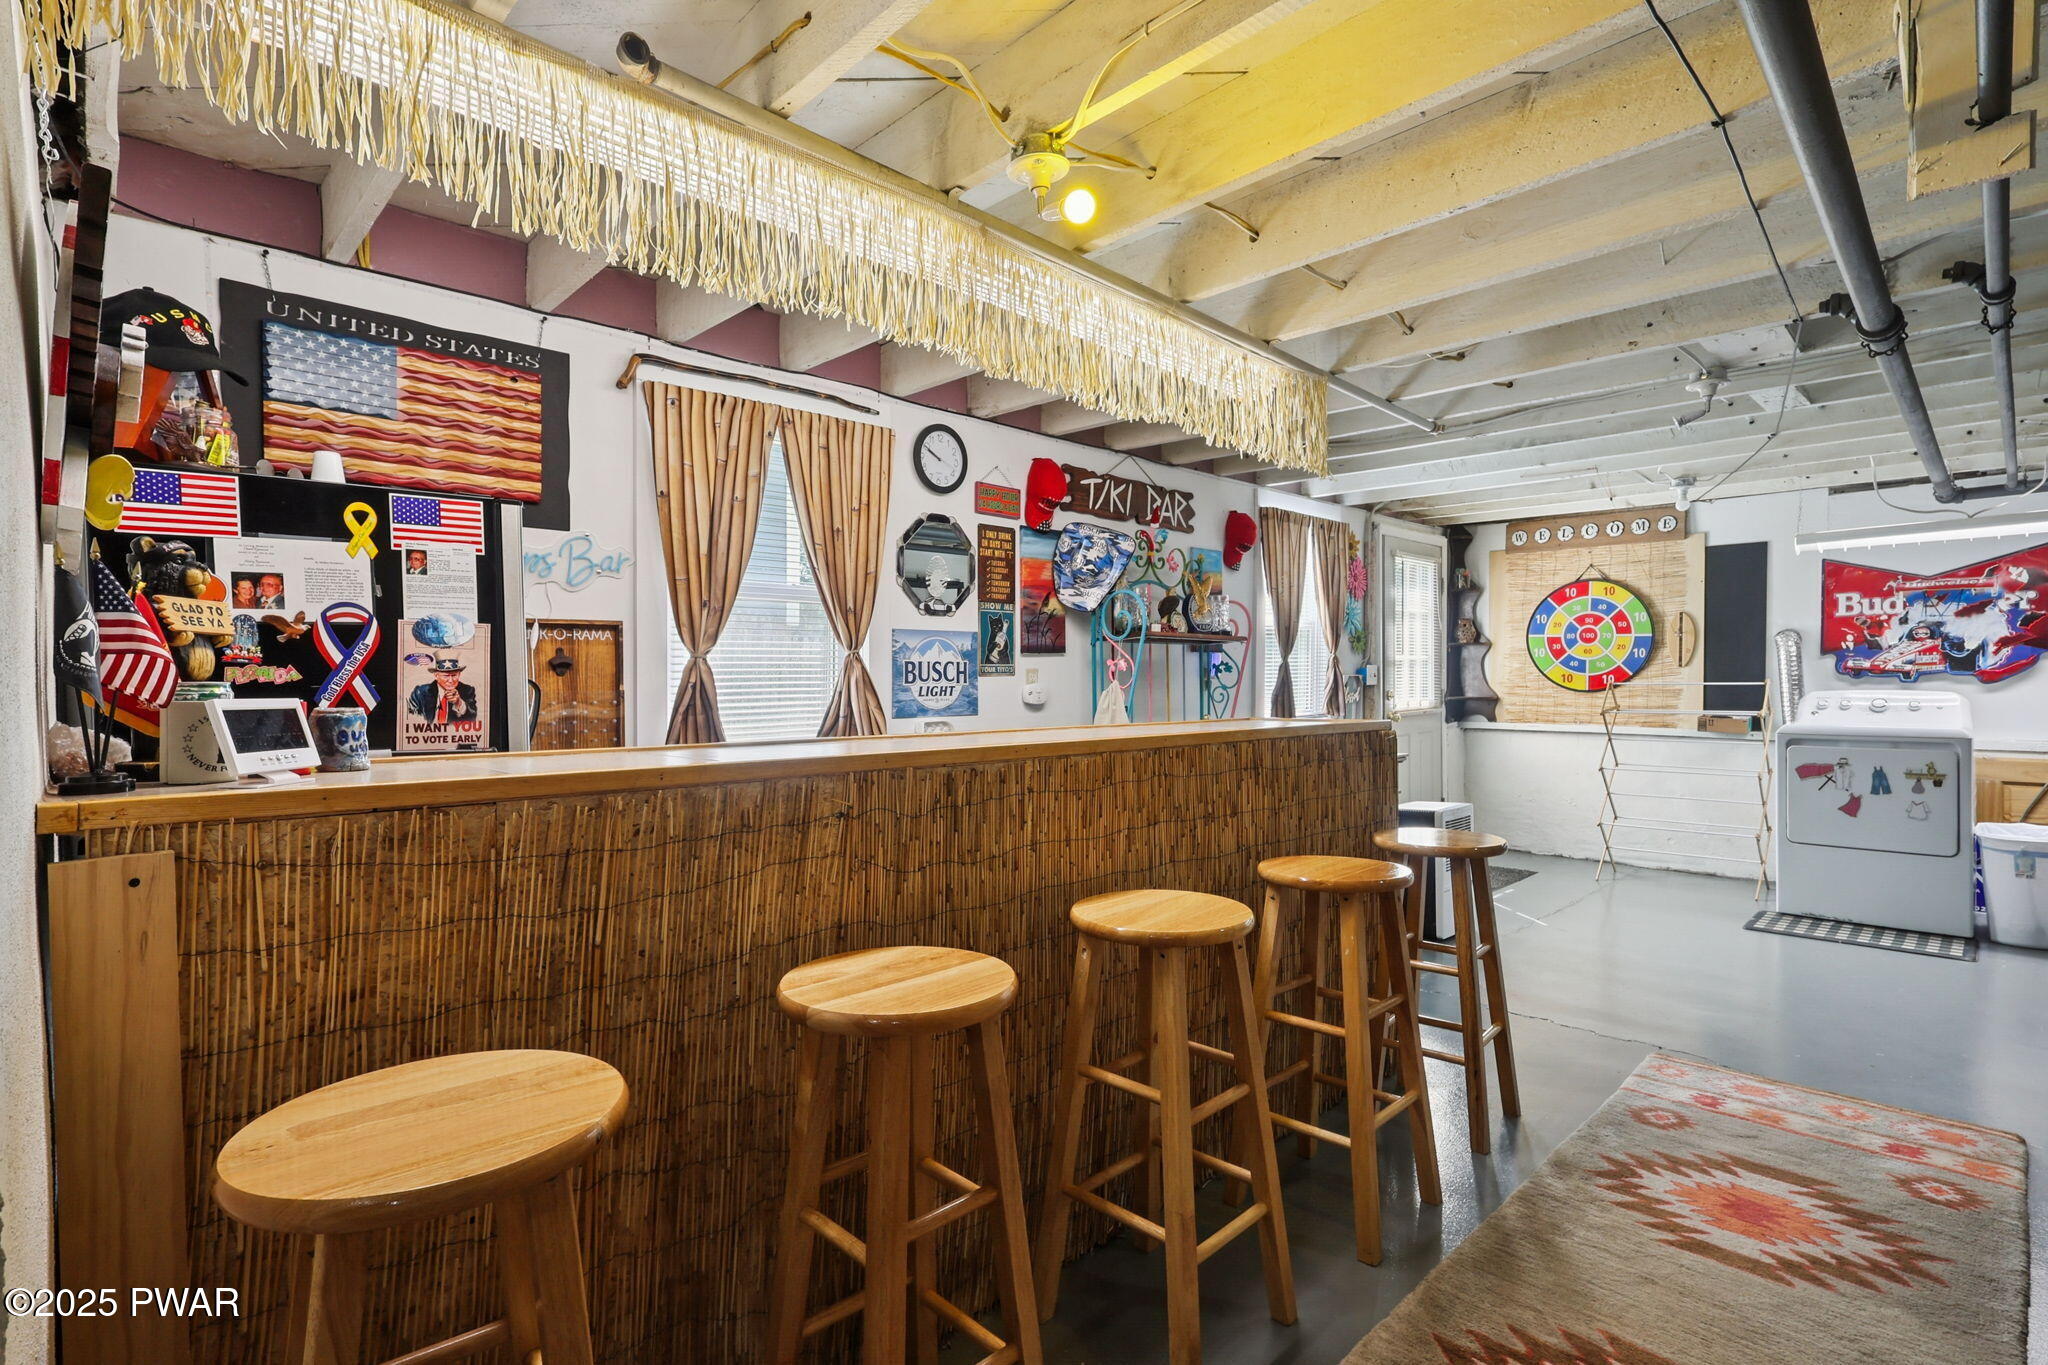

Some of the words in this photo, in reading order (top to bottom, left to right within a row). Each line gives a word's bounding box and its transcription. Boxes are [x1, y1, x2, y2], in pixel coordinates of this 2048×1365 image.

[266, 300, 414, 342] UNITED
[426, 334, 540, 369] STATES
[1080, 478, 1133, 516] TIKI
[1145, 485, 1187, 529] BAR
[985, 530, 997, 539] ONLY
[998, 532, 1012, 541] DRINK
[1515, 519, 1672, 542] WELCOME
[980, 547, 993, 557] START
[994, 549, 1005, 558] WITH
[558, 536, 631, 587] Bar
[1565, 588, 1577, 597] 10
[1603, 586, 1615, 596] 10
[172, 602, 203, 615] GLAD
[207, 606, 224, 617] TO
[980, 601, 1001, 610] SHOW
[1004, 602, 1014, 611] ME
[181, 615, 205, 627] SEE
[207, 619, 225, 628] YA
[1536, 614, 1547, 624] 10
[1634, 612, 1647, 622] 10
[527, 628, 612, 641] K-O-RAMA
[1533, 648, 1545, 657] 10
[1633, 648, 1646, 658] 10
[322, 685, 338, 701] God
[332, 668, 352, 688] Bless
[346, 655, 361, 669] the
[354, 641, 370, 657] USA
[904, 660, 968, 685] BUSCH
[1561, 674, 1573, 683] 10
[1602, 675, 1614, 684] 10
[918, 686, 955, 697] LIGHT
[406, 723, 409, 733] I
[413, 723, 450, 734] WANT
[453, 720, 482, 733] YOU
[406, 735, 420, 745] TO
[422, 735, 449, 744] VOTE
[451, 734, 482, 744] EARLY
[187, 754, 218, 772] NEVER
